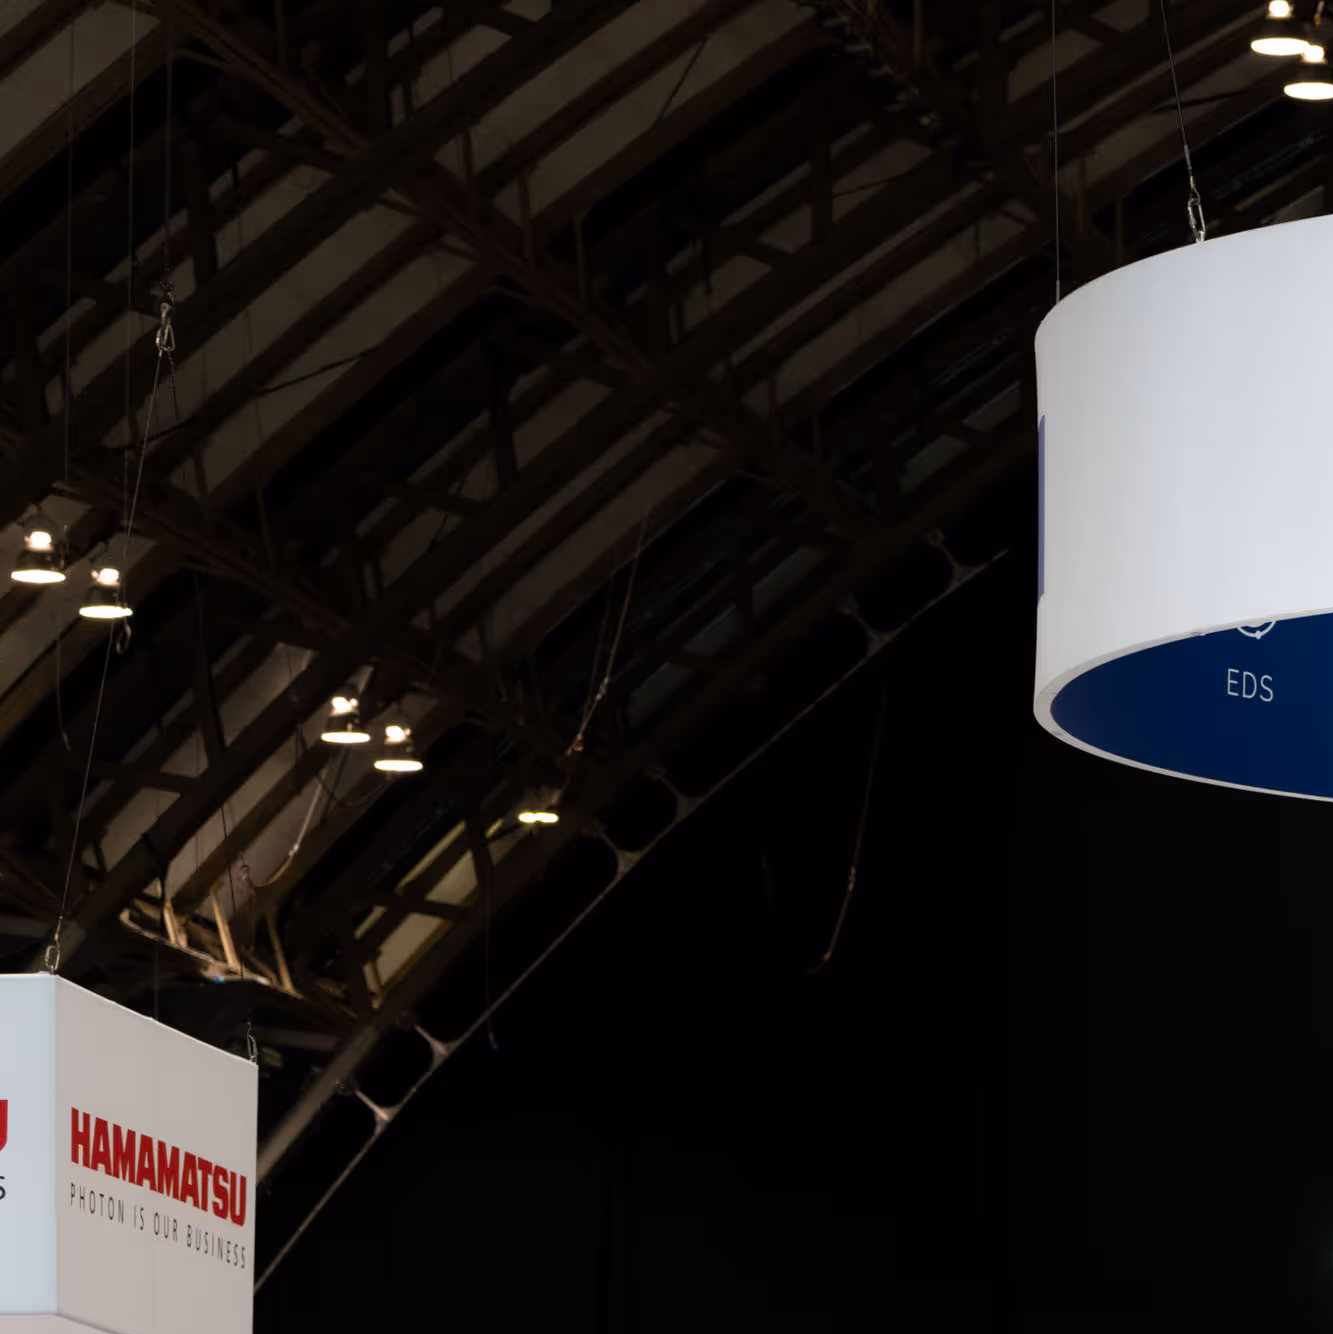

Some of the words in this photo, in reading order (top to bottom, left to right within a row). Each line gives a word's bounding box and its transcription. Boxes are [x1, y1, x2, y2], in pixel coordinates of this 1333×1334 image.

[1225, 666, 1275, 704] EDS
[71, 1106, 247, 1227] HAMAMATSU
[69, 1182, 125, 1224] PHOTON
[133, 1205, 145, 1231] IS
[153, 1212, 178, 1242] OUR
[186, 1224, 246, 1270] BUSINESS
